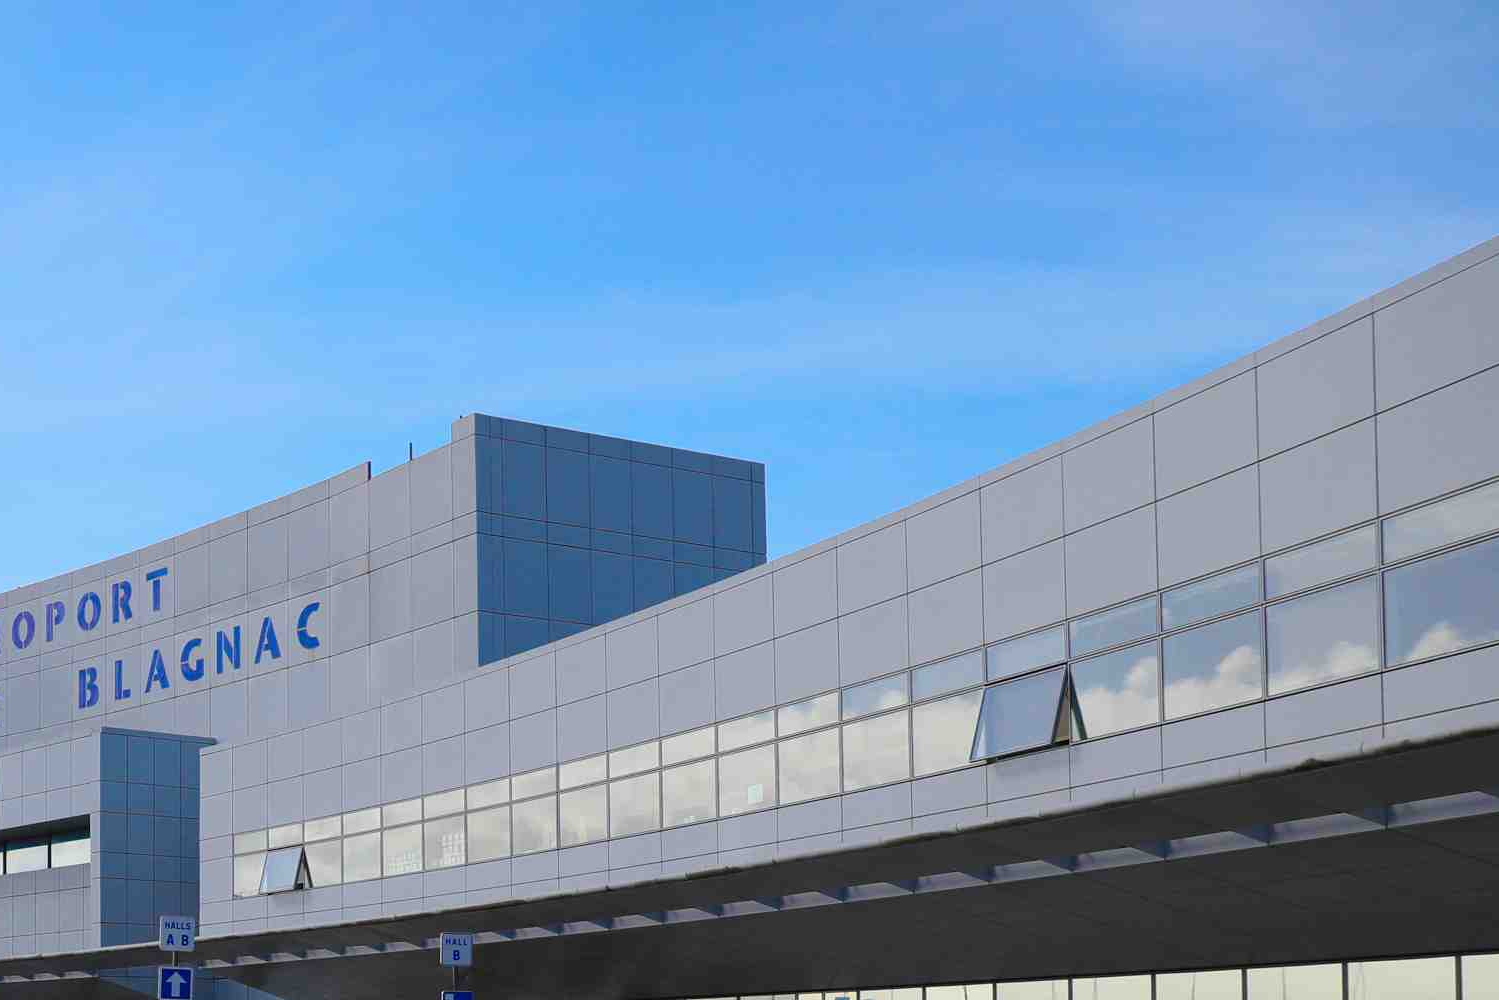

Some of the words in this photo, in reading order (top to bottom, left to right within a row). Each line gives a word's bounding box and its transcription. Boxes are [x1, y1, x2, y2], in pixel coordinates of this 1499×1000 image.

[78, 602, 321, 710] BLAGNAC
[164, 920, 192, 930] HALLS
[167, 934, 175, 945] A
[181, 934, 189, 946] B
[445, 936, 468, 946] HALL
[453, 950, 460, 961] B
